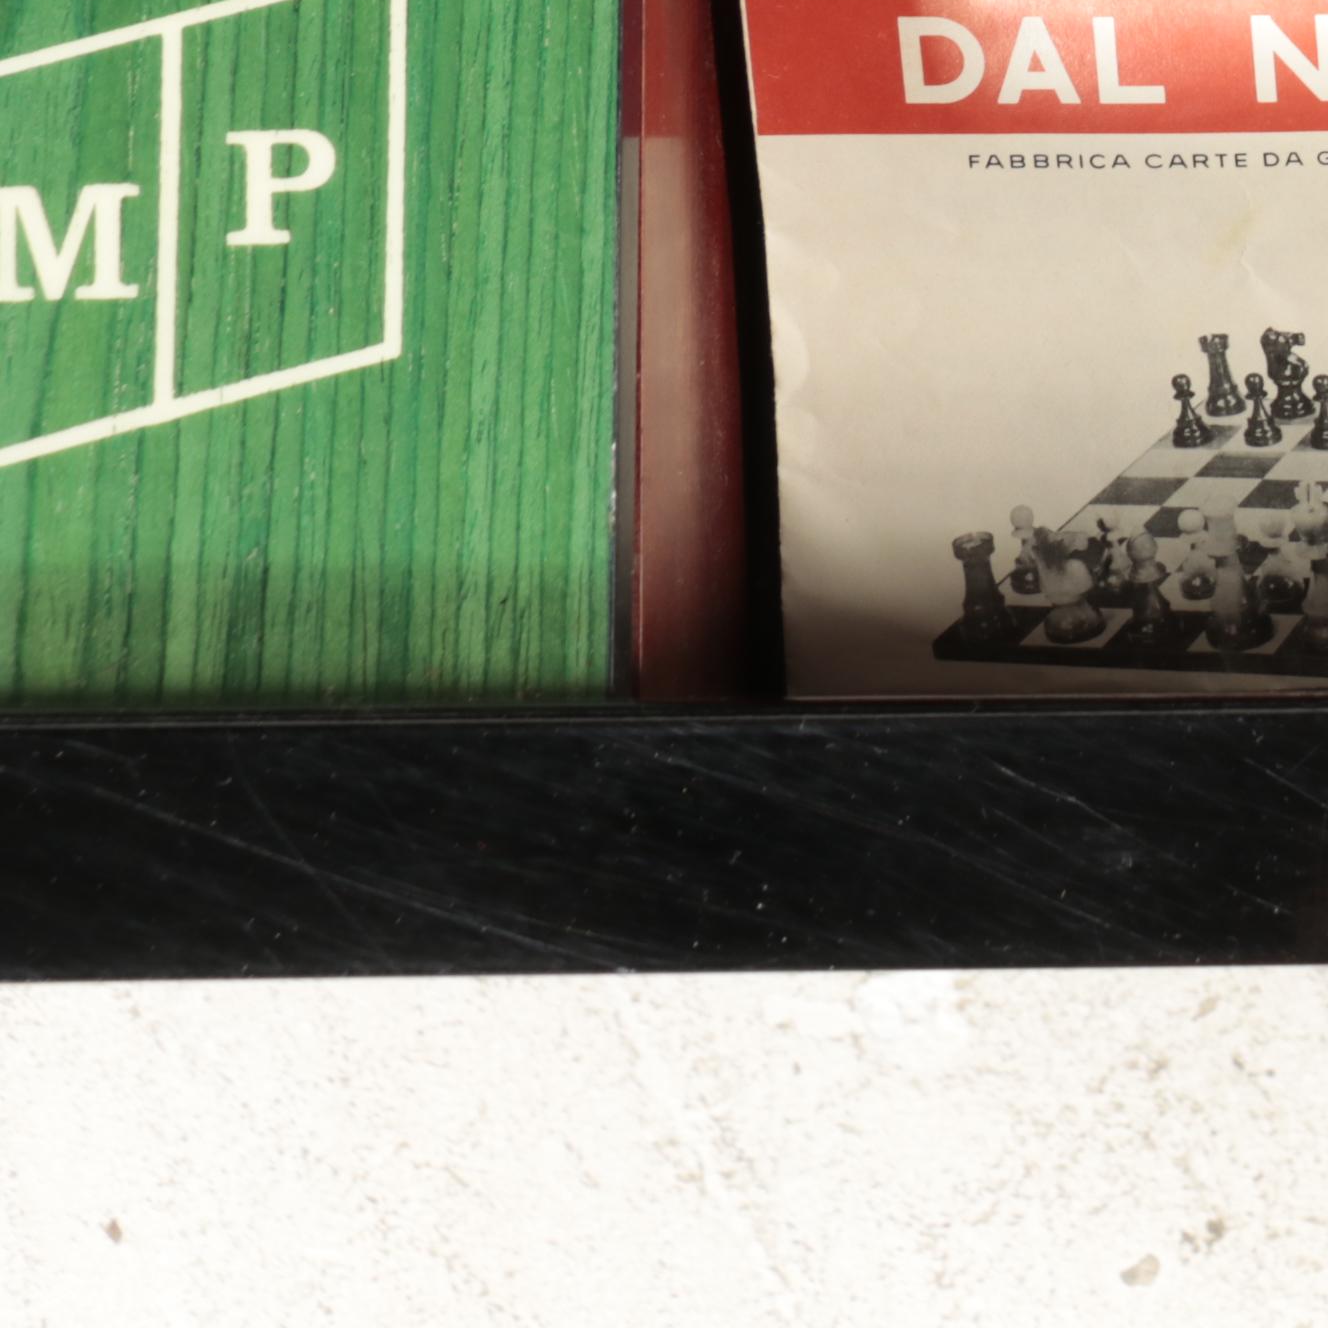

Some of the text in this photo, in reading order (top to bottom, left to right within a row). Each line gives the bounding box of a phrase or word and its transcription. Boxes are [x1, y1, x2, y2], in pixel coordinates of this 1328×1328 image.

[897, 15, 1166, 105] DAL
[225, 128, 337, 247] P
[968, 153, 1131, 170] FABBRICA
[1144, 152, 1247, 169] CARTE
[1262, 151, 1304, 168] DA
[0, 182, 140, 303] M
